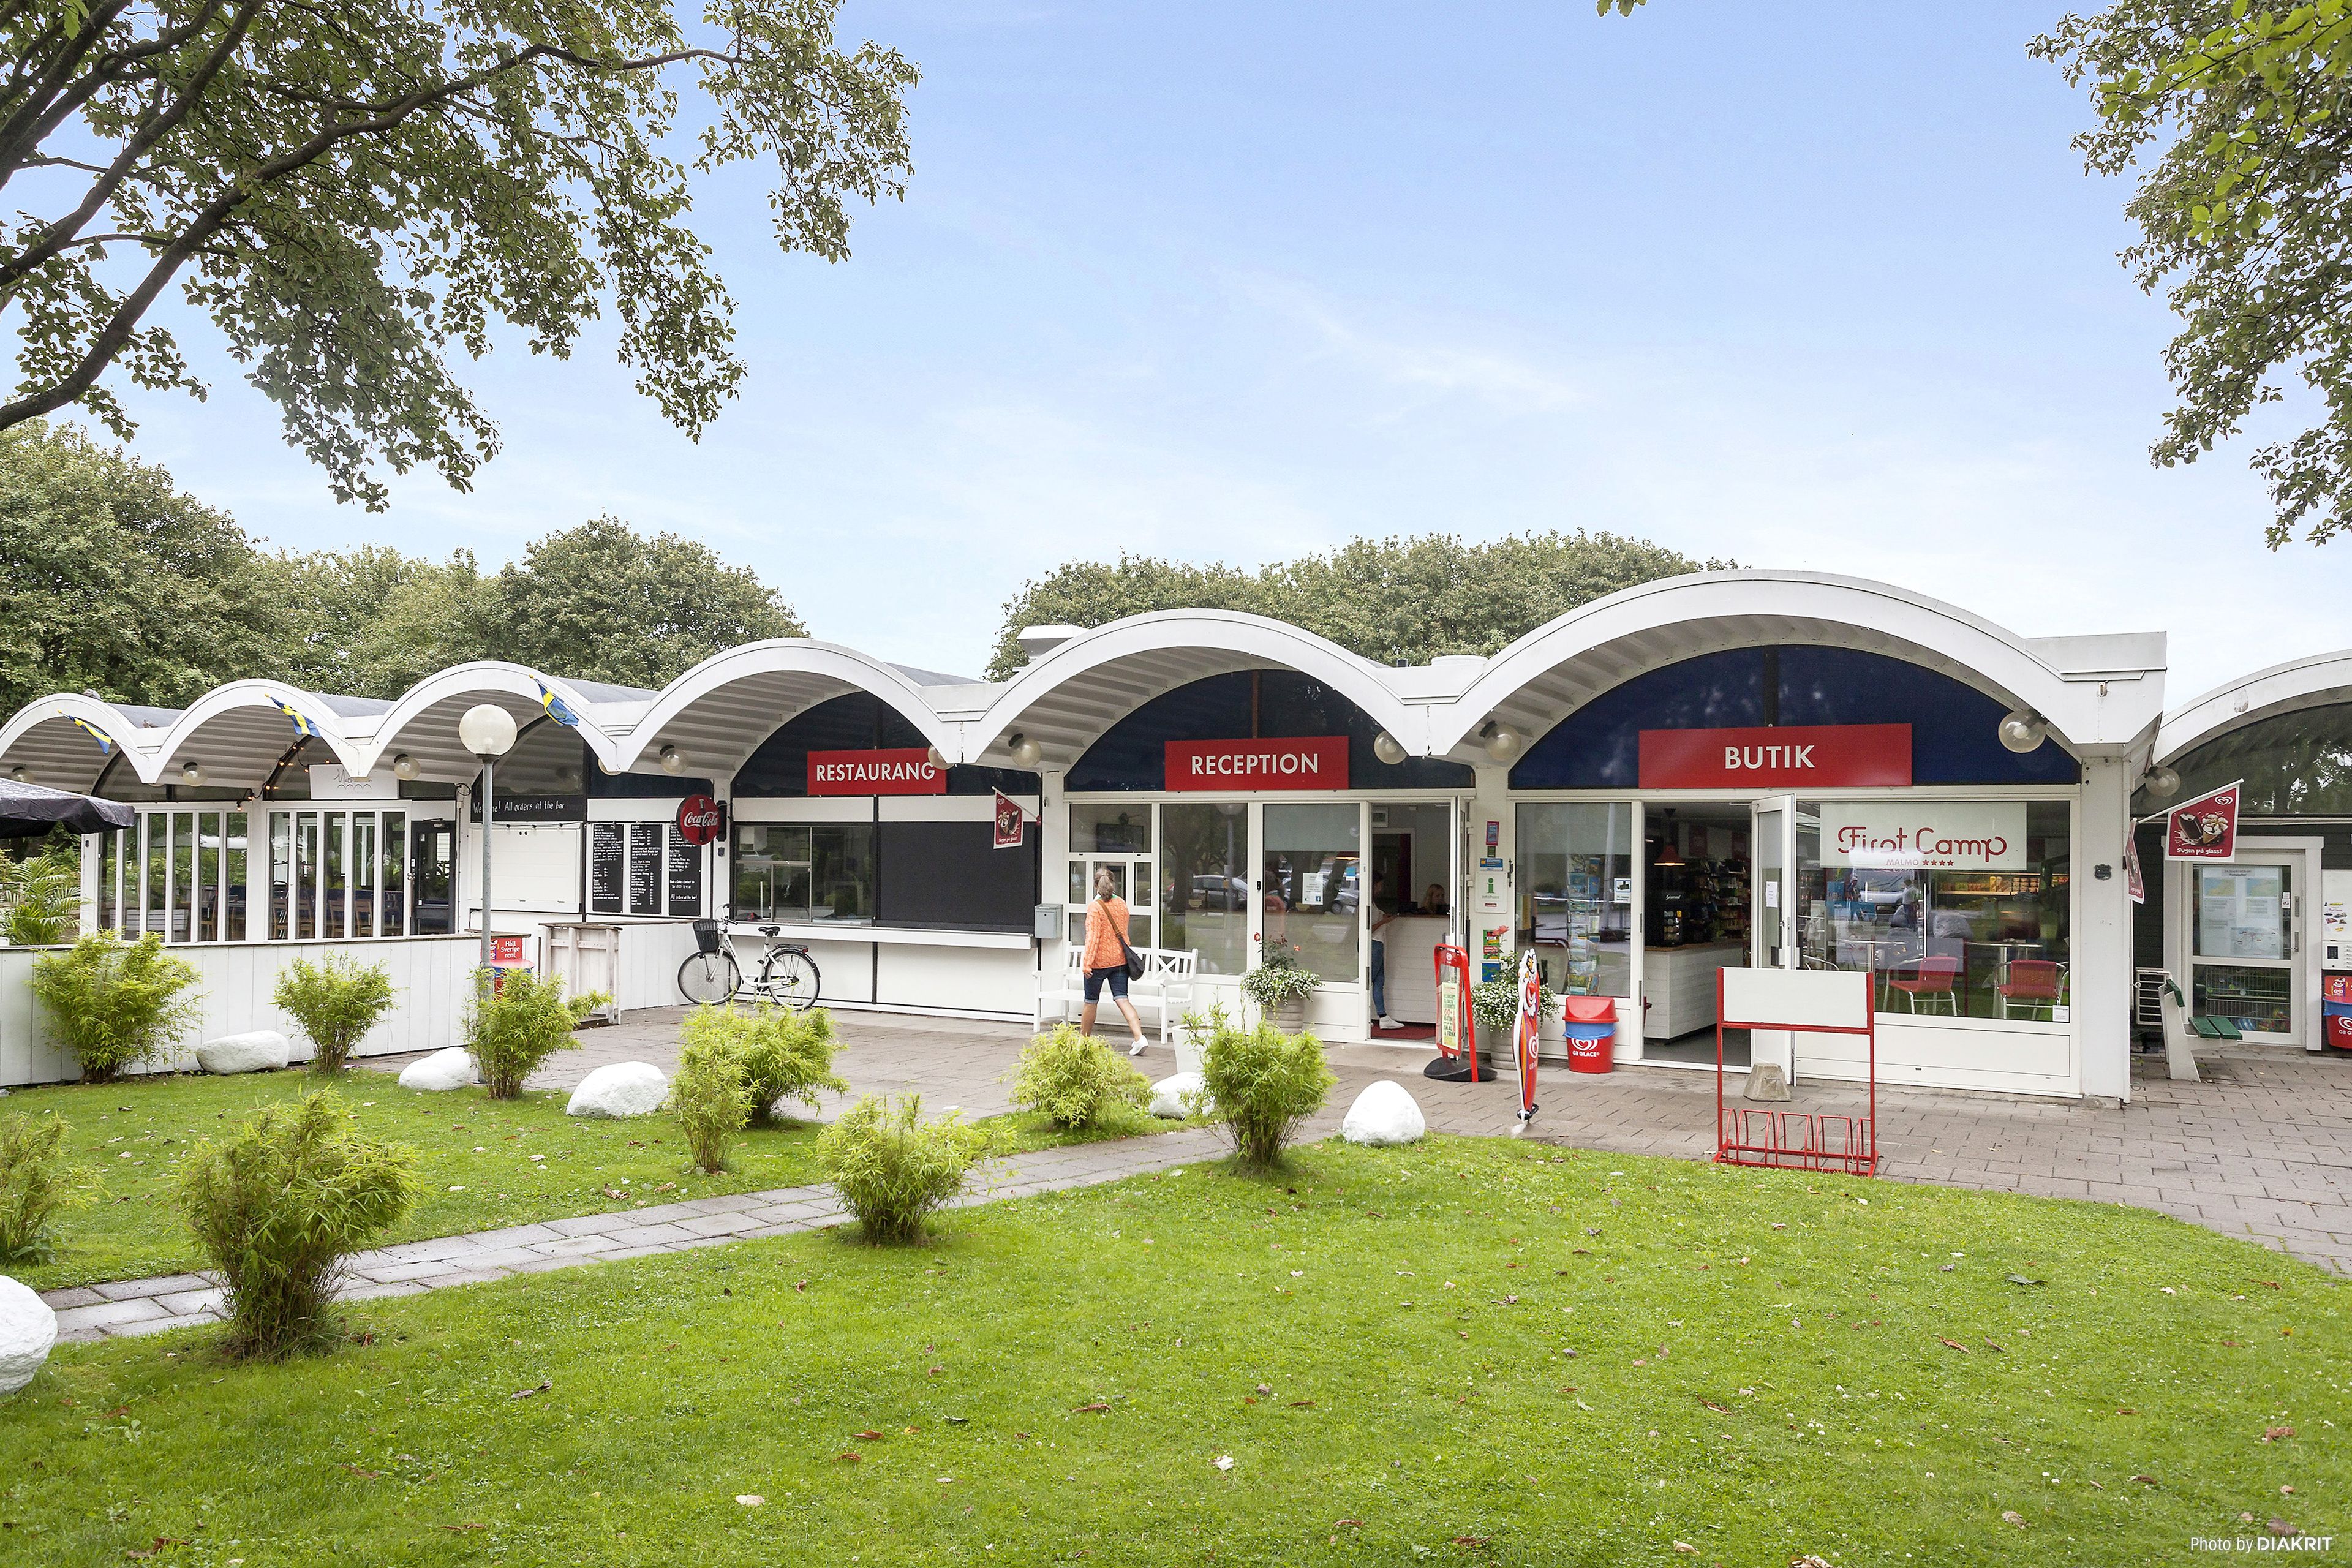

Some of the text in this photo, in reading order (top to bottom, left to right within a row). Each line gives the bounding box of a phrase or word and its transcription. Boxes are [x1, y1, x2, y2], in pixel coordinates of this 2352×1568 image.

[1191, 753, 1318, 775] RECEPTION
[1725, 745, 1815, 769] BUTIK
[816, 761, 935, 782] RESTAURANG
[504, 801, 513, 812] All
[514, 803, 532, 812] orders
[535, 801, 541, 810] at
[544, 800, 553, 810] the
[556, 800, 564, 810] bar
[1838, 826, 2007, 862] First Camp
